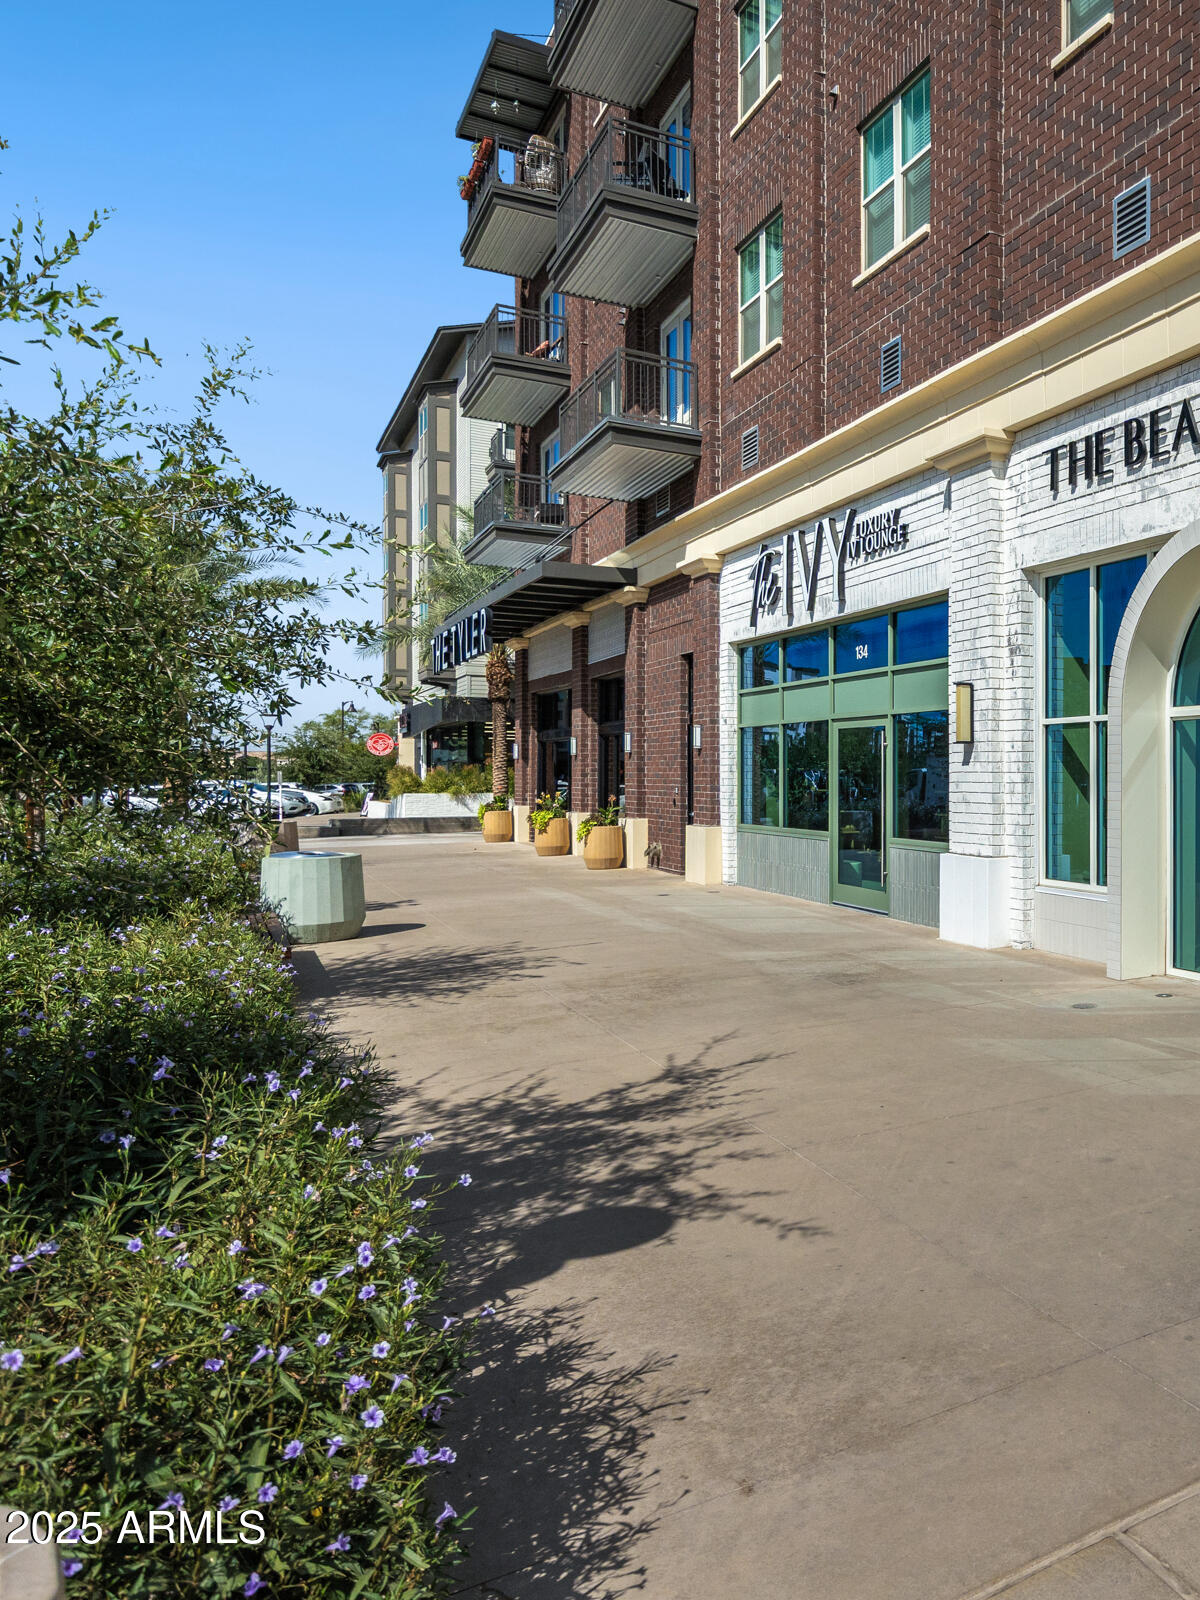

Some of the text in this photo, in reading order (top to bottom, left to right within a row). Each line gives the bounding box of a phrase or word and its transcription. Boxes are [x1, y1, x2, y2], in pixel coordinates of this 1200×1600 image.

[1043, 425, 1113, 492] THE
[855, 509, 898, 540] LUXURY
[860, 524, 905, 554] LOUNGE
[748, 508, 856, 628] The IVY
[430, 608, 487, 675] THE TYLER
[855, 644, 868, 660] 134
